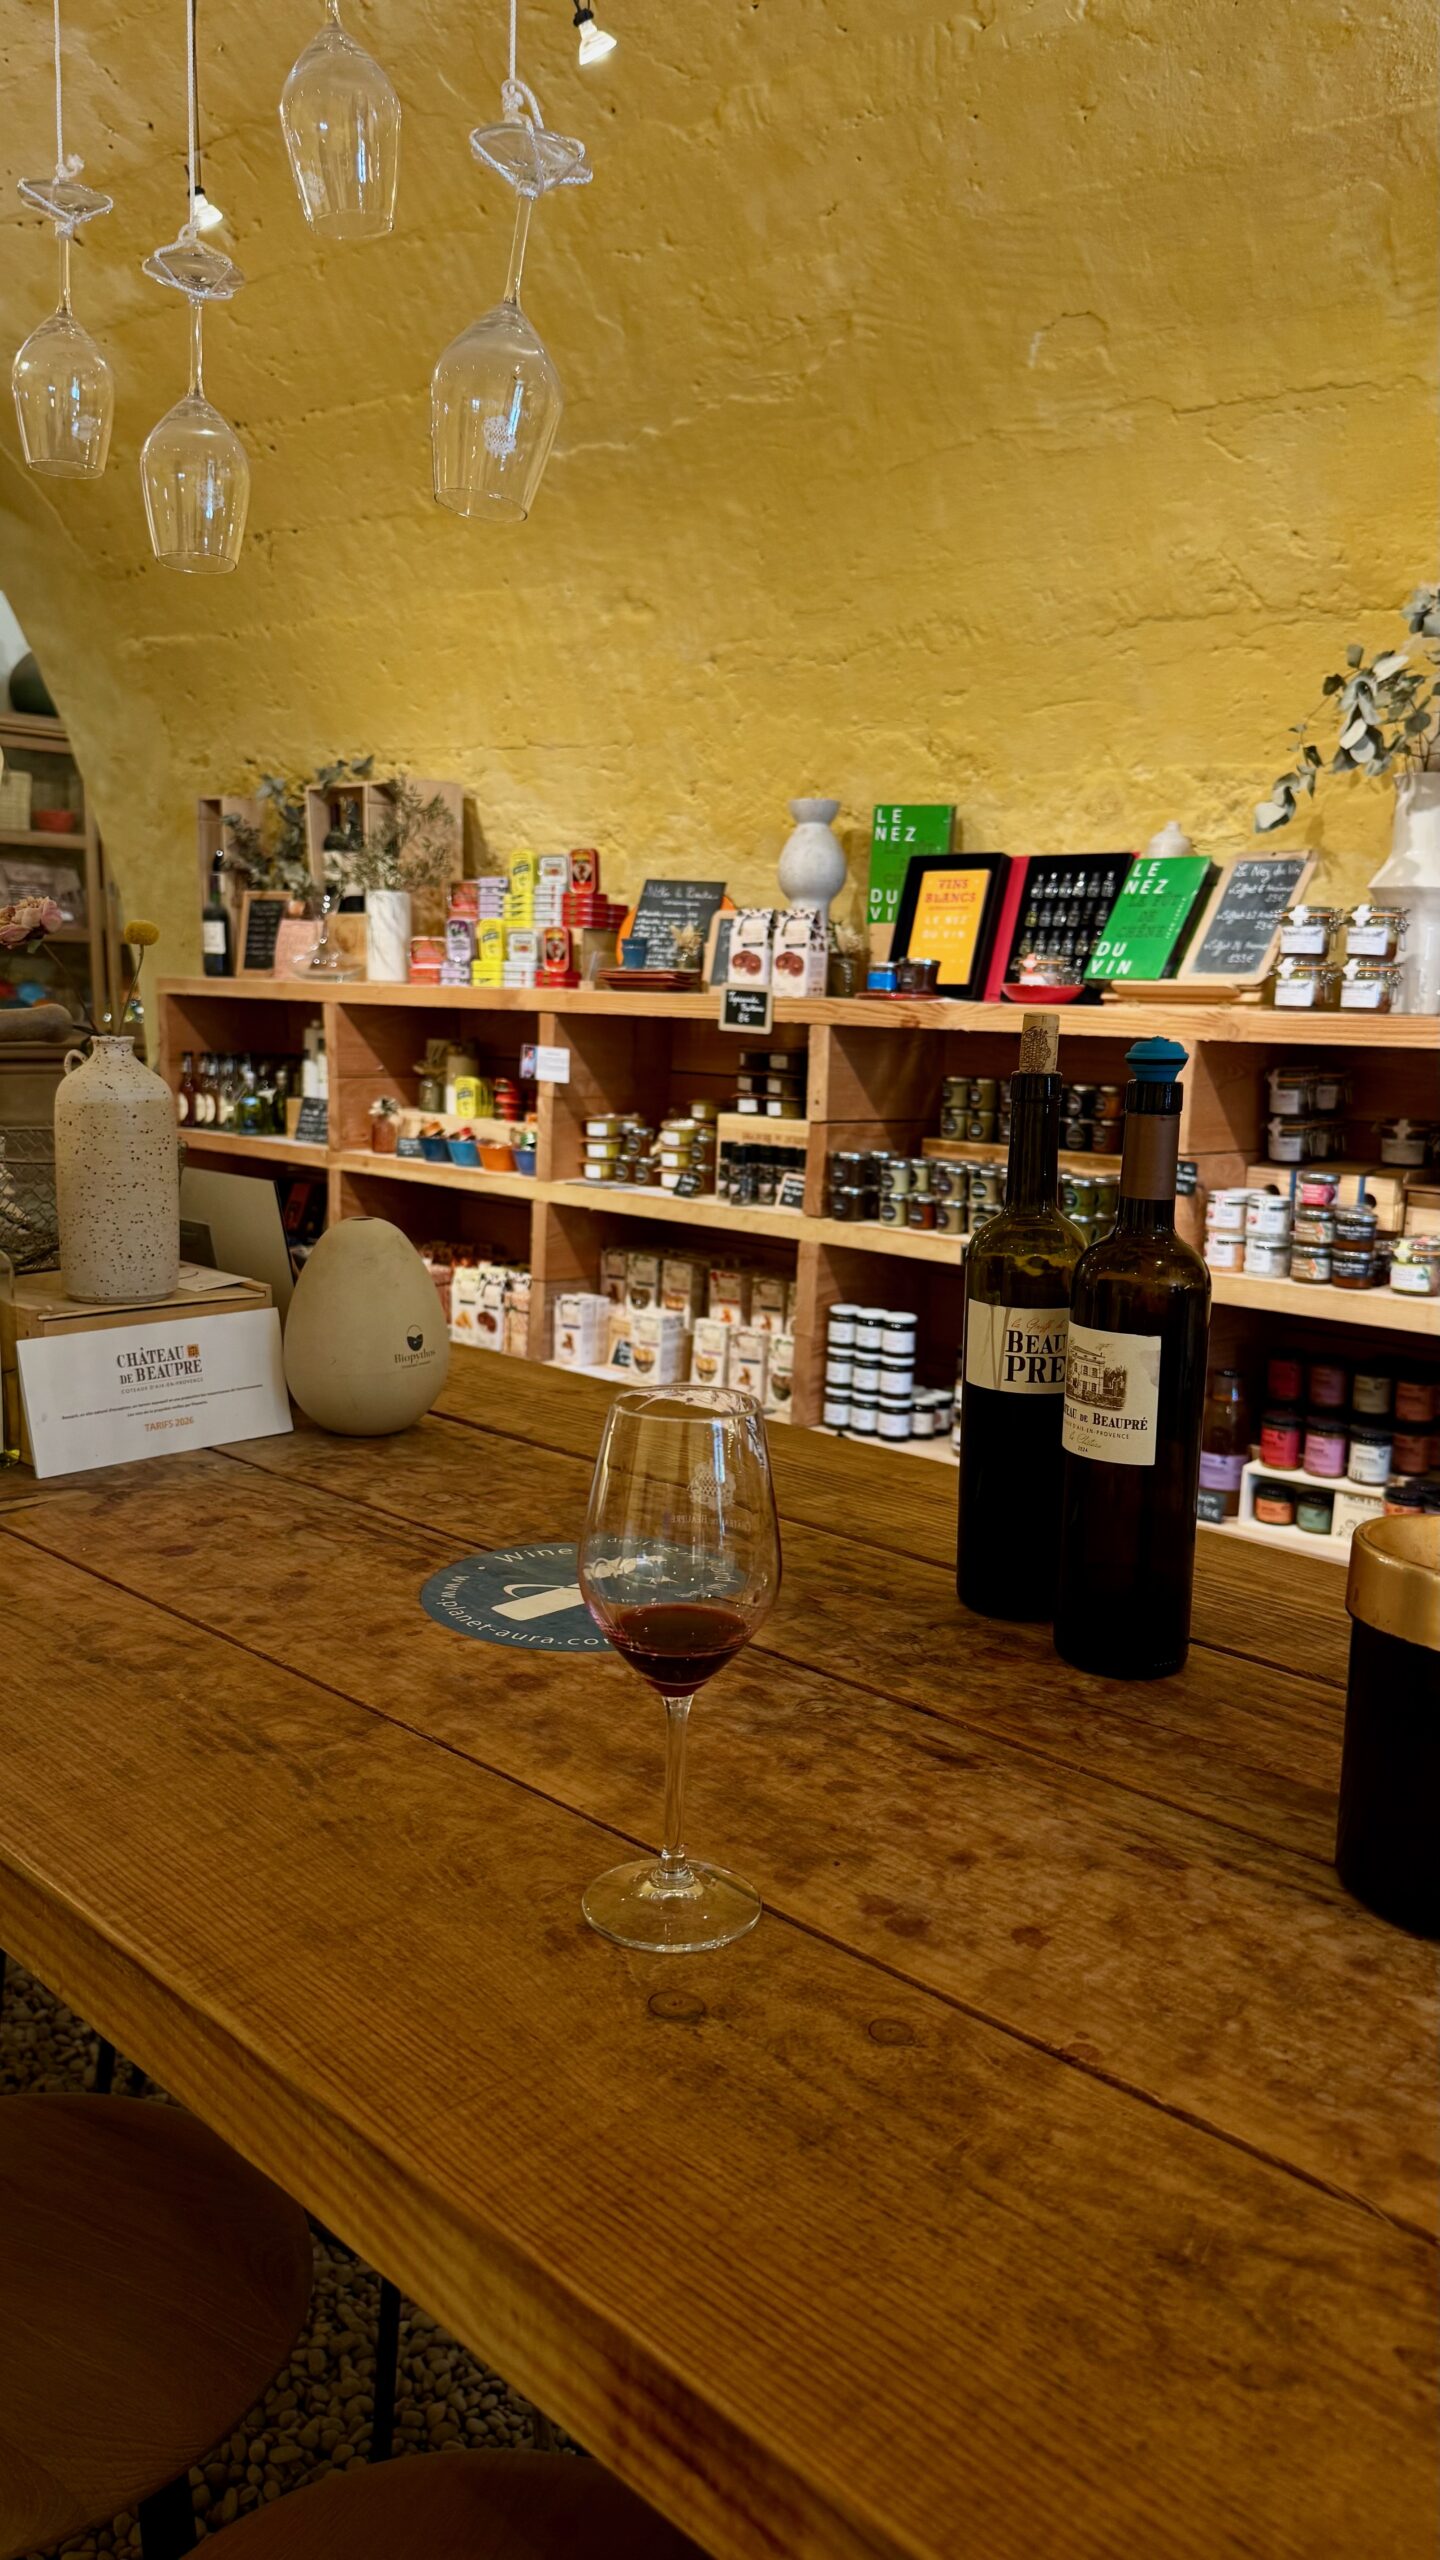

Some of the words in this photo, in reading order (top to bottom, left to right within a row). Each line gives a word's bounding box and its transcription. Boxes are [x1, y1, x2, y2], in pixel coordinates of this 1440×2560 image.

[877, 808, 902, 823] LE
[875, 826, 916, 842] NEZ
[1133, 862, 1161, 877] LE
[938, 879, 969, 889] VINS
[1123, 879, 1169, 894] NEZ
[870, 888, 899, 904] DU
[924, 892, 977, 904] BLANCS
[869, 907, 894, 921] VI
[924, 916, 940, 925] LE
[944, 916, 969, 925] NEZ
[922, 929, 938, 939] DU
[943, 929, 966, 939] VIN
[1095, 941, 1128, 957] DU
[1090, 958, 1133, 975] VIN
[1004, 1329, 1068, 1355] BEAU
[116, 1345, 185, 1369] CHÂTEAU
[119, 1373, 134, 1385] DE
[144, 1419, 174, 1433] TARIFS
[1092, 1412, 1148, 1431] BEAUPRÉ
[494, 1547, 574, 1564] Wine
